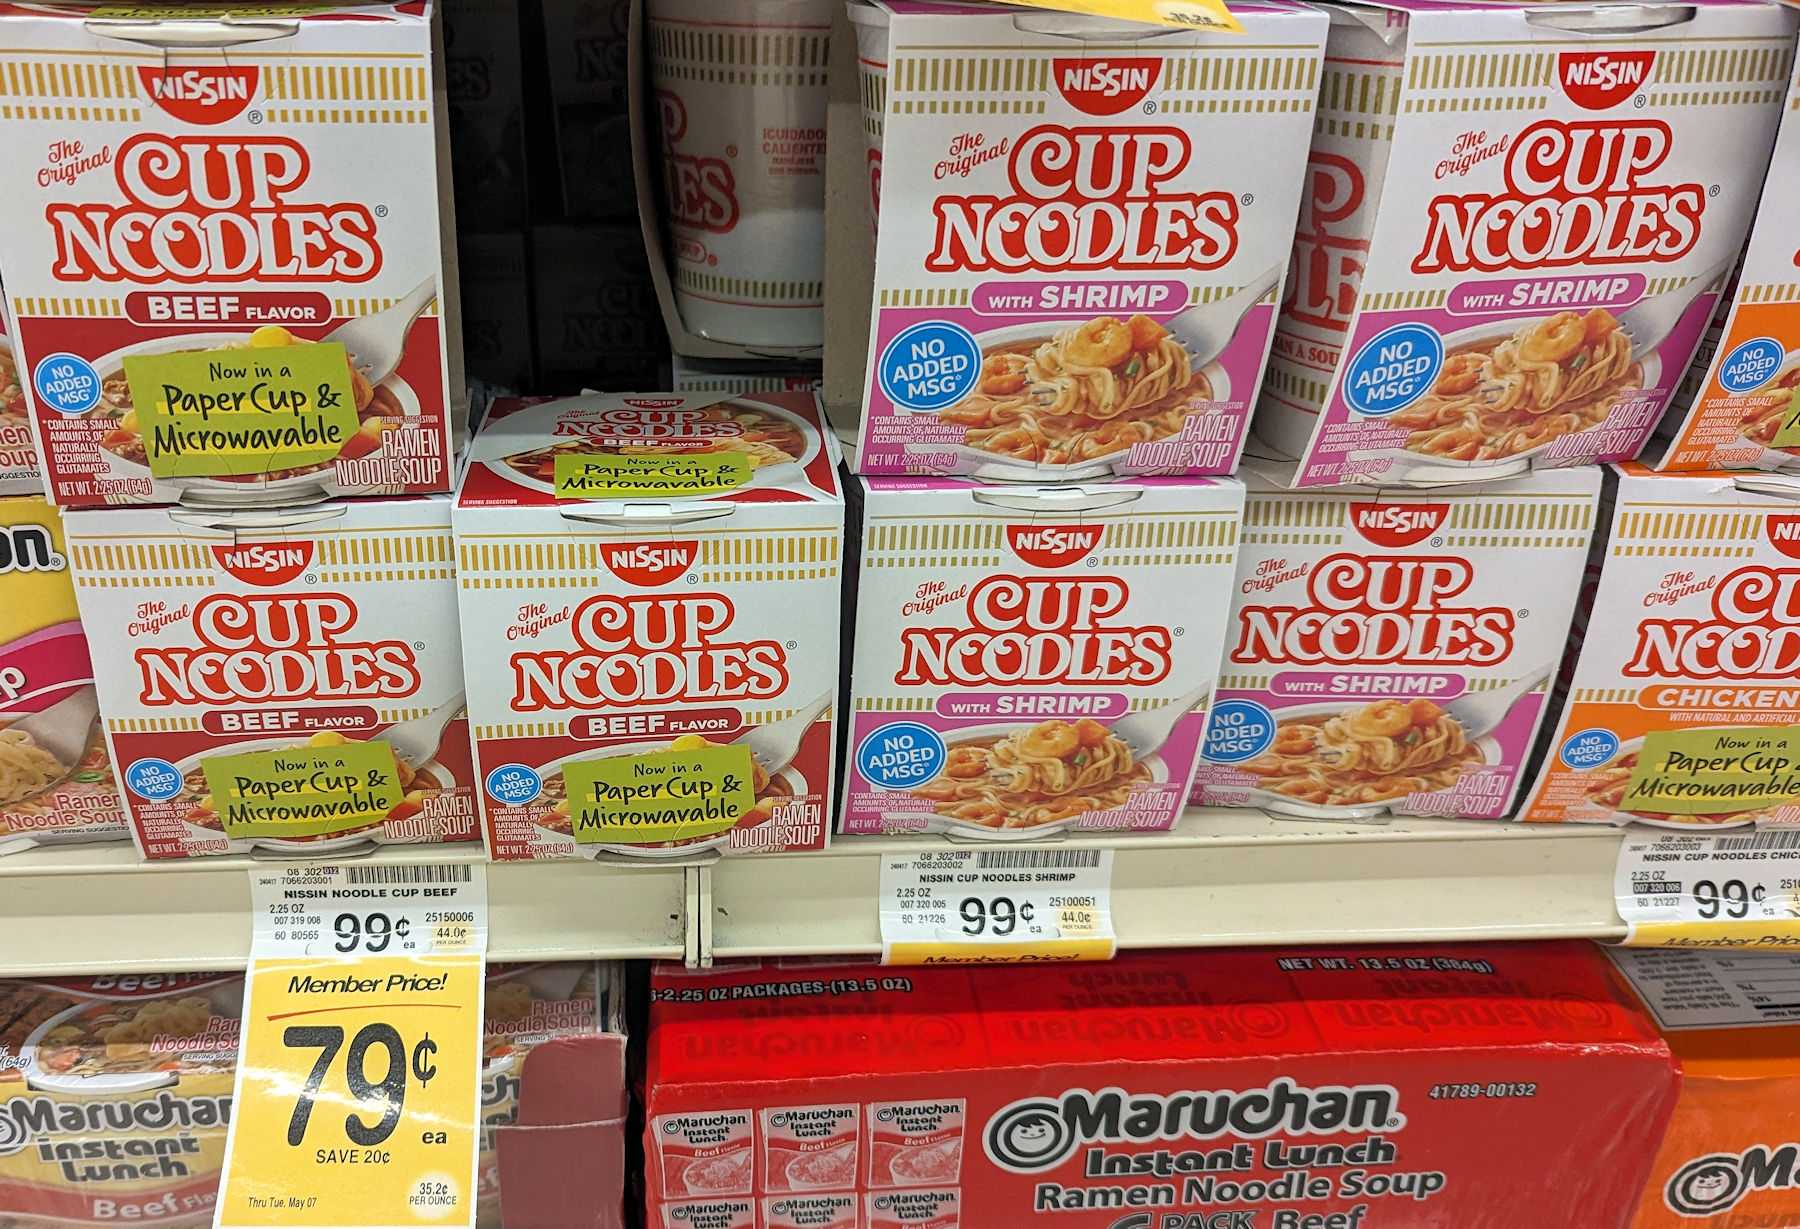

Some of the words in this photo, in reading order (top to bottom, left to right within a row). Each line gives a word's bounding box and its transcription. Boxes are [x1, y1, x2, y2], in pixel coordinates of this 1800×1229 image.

[1063, 62, 1149, 96] NISSIN
[1566, 57, 1643, 91] NISSIN
[152, 70, 249, 105] NISSIN
[48, 139, 83, 162] The
[949, 132, 985, 157] The
[37, 145, 112, 188] Original
[933, 138, 1009, 180] Original
[1008, 124, 1191, 201] CUP
[1504, 120, 1672, 197] CUP
[116, 133, 310, 210] CUP
[925, 192, 1239, 272] NOODLES
[1411, 184, 1705, 272] NOODLES
[46, 203, 383, 285] NOODLES
[988, 294, 1033, 309] WITH
[1039, 285, 1170, 309] SHRIMP
[1462, 293, 1505, 308] WITH
[1508, 278, 1629, 306] SHRIMP
[148, 296, 239, 320] BEEF
[246, 306, 316, 320] FLAVOR
[910, 338, 946, 361] NO
[1378, 341, 1410, 361] NO
[1742, 348, 1764, 361] NO
[51, 364, 75, 382] NO
[209, 362, 247, 380] Now
[254, 364, 272, 378] in
[278, 367, 291, 378] a
[892, 353, 969, 383] ADDED
[1355, 355, 1431, 390] ADDED
[1726, 357, 1775, 377] ADDED
[46, 374, 93, 392] ADDED
[162, 384, 253, 421] Paper
[249, 383, 309, 417] Cup
[317, 384, 341, 408] &
[629, 399, 679, 408] NISSIN
[90, 420, 119, 430] SMALL
[601, 410, 709, 425] CUP
[1602, 400, 1657, 430] RAMEN
[50, 431, 92, 441] AMOUNTS
[93, 431, 104, 441] OF
[153, 415, 342, 458] Microwavable
[552, 422, 747, 438] NOODLES
[873, 426, 911, 434] AMOUNTS
[925, 426, 968, 434] NATURALLY
[1180, 414, 1238, 442] RAMEN
[52, 442, 99, 453] NATURALLY
[381, 428, 440, 457] RAMEN
[872, 435, 914, 443] OCCURRING
[916, 435, 965, 443] GLUTAMATES
[54, 453, 101, 463] OCCURRING
[1127, 441, 1189, 468] NOODLE
[1187, 441, 1232, 468] SOUP
[57, 463, 111, 474] GLUTAMATES
[336, 458, 399, 486] NOODLE
[400, 458, 441, 484] SOUP
[58, 482, 75, 496] NET
[76, 481, 93, 496] WT.
[561, 475, 737, 490] Microwavable
[1358, 506, 1438, 533] NISSIN
[1015, 528, 1093, 555] NISSIN
[223, 546, 304, 573] NISSIN
[611, 546, 688, 573] NISSIN
[1306, 553, 1473, 611] CUP
[967, 574, 1129, 633] CUP
[193, 593, 358, 651] CUP
[572, 592, 735, 653] CUP
[1230, 606, 1515, 667] NOODLES
[895, 626, 1171, 687] NOODLES
[135, 641, 421, 706] NOODLES
[510, 640, 789, 713] NOODLES
[1285, 681, 1325, 692] WITH
[1328, 675, 1448, 693] SHRIMP
[951, 702, 991, 713] WITH
[995, 695, 1111, 713] SHRIMP
[1657, 689, 1798, 707] CHICKEN
[221, 711, 299, 731] BEEF
[304, 716, 365, 728] FLAVOR
[588, 715, 666, 736] BEEF
[669, 718, 729, 731] FLAVOR
[1694, 713, 1731, 722] NATURAL
[1732, 713, 1751, 722] AND
[868, 746, 935, 769] ADDED
[1663, 752, 1734, 775] Paper
[1739, 752, 1790, 775] Cup
[234, 775, 314, 800] Paper
[310, 772, 359, 793] Cup
[593, 779, 671, 803] Paper
[666, 776, 714, 799] Cup
[228, 792, 390, 826] Microwavable
[1124, 791, 1175, 811] RAMEN
[6, 810, 78, 831] Noodle
[579, 797, 739, 831] Microwavable
[912, 861, 963, 869] 7066203002
[1643, 853, 1680, 862] NISSIN
[1685, 853, 1707, 861] CUP
[1712, 852, 1767, 860] NOODLES
[280, 877, 332, 885] 7066203001
[919, 874, 953, 883] NISSIN
[957, 874, 978, 882] CUP
[982, 874, 1032, 882] NOODLES
[1035, 873, 1076, 882] SHRIMP
[284, 890, 327, 899] NISSIN
[332, 889, 387, 898] NOODLE
[393, 889, 419, 897] CUP
[423, 888, 458, 896] BEEF
[896, 888, 915, 897] 2.25
[918, 888, 931, 897] OZ
[1049, 897, 1096, 907] 25100051
[270, 904, 289, 914] 2.25
[291, 904, 304, 913] OZ
[916, 900, 930, 908] 320
[275, 916, 288, 924] 007
[291, 916, 304, 924] 319
[307, 916, 320, 924] 008
[425, 912, 474, 922] 25150006
[918, 915, 945, 923] 21226
[1061, 912, 1091, 923] 44.0¢
[291, 931, 319, 940] 80565
[437, 927, 466, 938] 44.0¢
[403, 940, 416, 949] ea
[1278, 958, 1313, 970] NET
[1317, 958, 1353, 969] WT.
[288, 976, 383, 994] Member
[386, 973, 448, 991] Price!
[882, 979, 911, 991] OZ)
[1429, 1082, 1537, 1100] 41789-00132
[677, 1114, 748, 1128] Maruchan
[1058, 1081, 1399, 1140] Maruchan
[421, 1130, 447, 1145] ea
[315, 1150, 359, 1165] SAVE
[363, 1149, 390, 1166] 20¢
[1085, 1145, 1254, 1178] Instant
[1263, 1137, 1395, 1170] Lunch
[61, 1156, 188, 1183] Lunch
[419, 1182, 449, 1196] 35.2¢
[1033, 1183, 1174, 1211] Ramen
[1184, 1173, 1330, 1204] Noodle
[1339, 1170, 1445, 1200] Soup
[93, 1193, 179, 1219] Beef
[247, 1196, 267, 1209] Thru
[269, 1197, 287, 1208] Tue.
[288, 1197, 302, 1211] May
[303, 1196, 317, 1208] 07
[409, 1195, 426, 1206] PER
[427, 1195, 457, 1206] OUNCE
